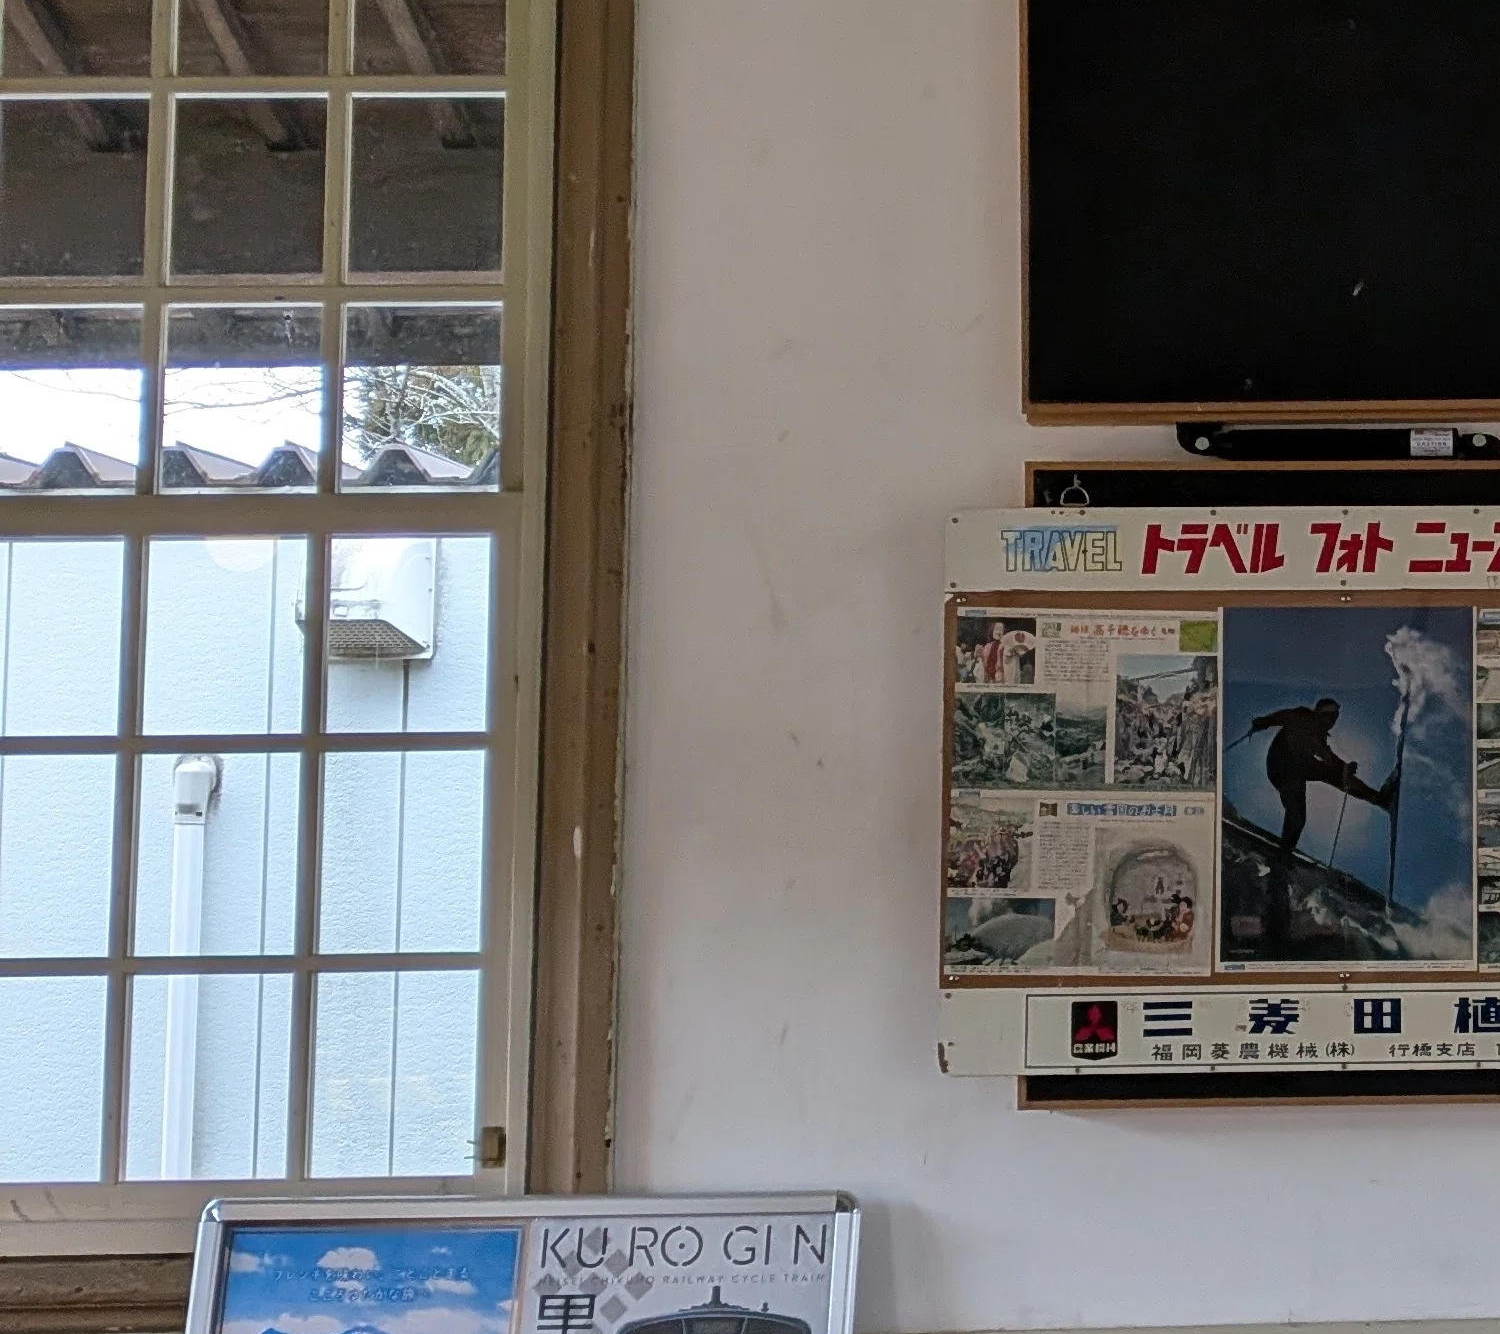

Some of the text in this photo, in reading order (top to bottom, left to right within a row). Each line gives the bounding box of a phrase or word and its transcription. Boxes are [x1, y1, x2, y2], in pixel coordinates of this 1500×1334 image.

[1000, 529, 1123, 573] TRAVEL
[1141, 523, 1285, 575] トラベル
[1309, 521, 1394, 574] フォト
[1388, 1042, 1477, 1058] 行橋支店
[662, 1274, 725, 1285] RAILWAY
[731, 1273, 776, 1284] CYCLE
[783, 1273, 825, 1283] TRAIN
